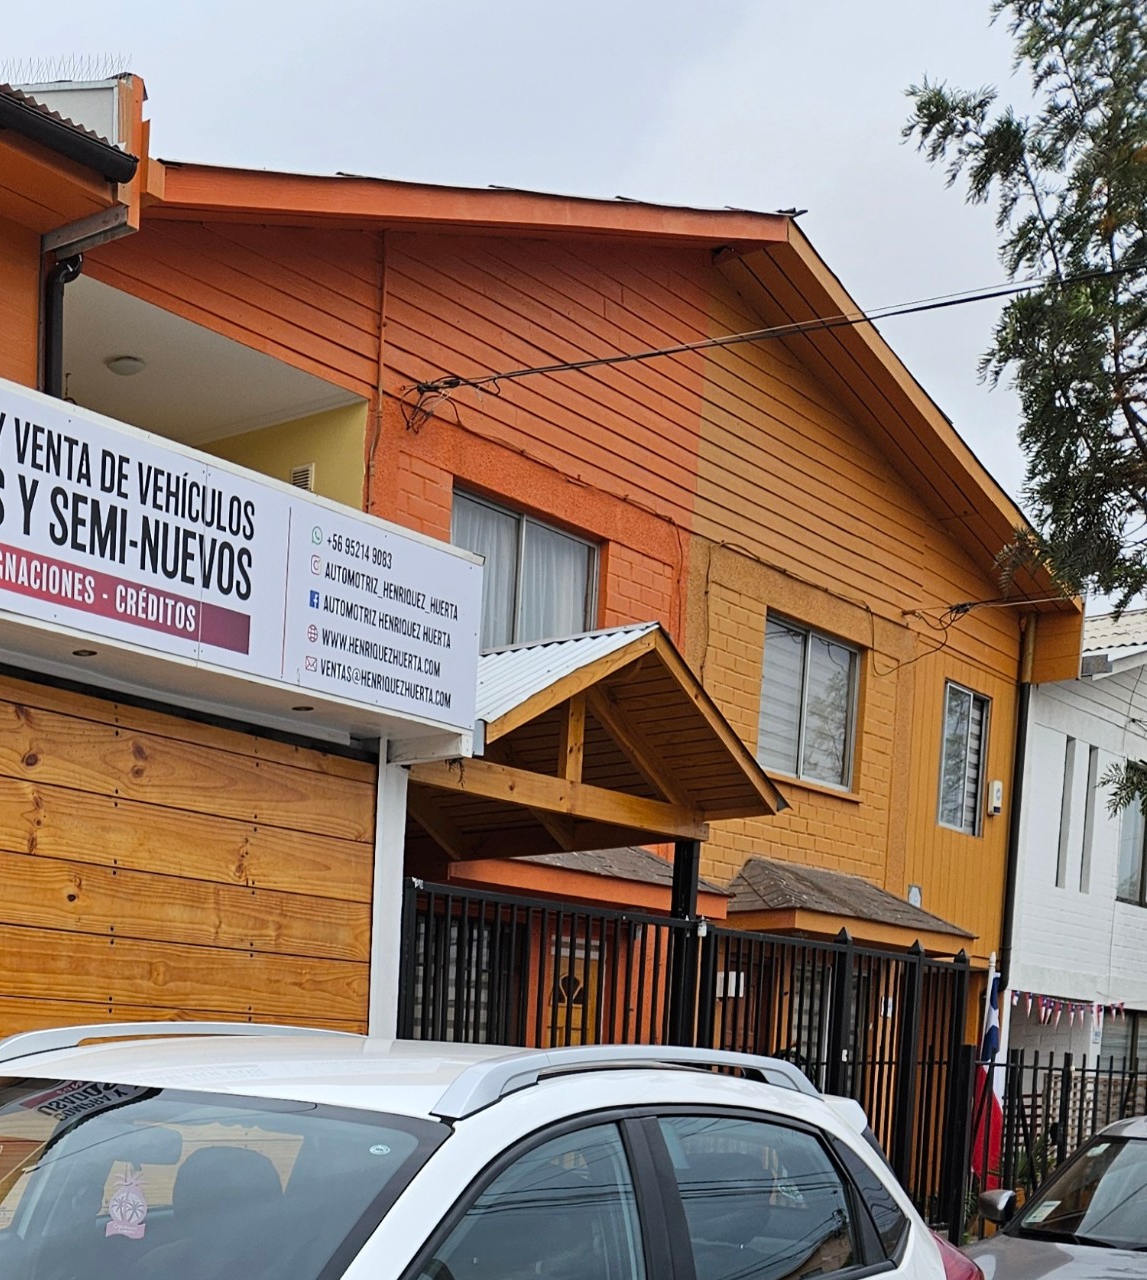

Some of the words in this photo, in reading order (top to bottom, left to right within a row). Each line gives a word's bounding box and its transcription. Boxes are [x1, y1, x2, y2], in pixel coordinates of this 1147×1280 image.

[14, 416, 92, 488] VENTA
[100, 448, 129, 500] DE
[137, 461, 255, 541] VEHÍCULOS
[18, 474, 40, 536] Y
[49, 486, 253, 601] SEMI-NUEVOS
[326, 533, 343, 552] +56
[345, 537, 370, 562] 95214
[371, 546, 393, 570] 9083
[115, 583, 196, 633] CRÉDITOS
[323, 595, 377, 627] AUTOMOTRIZ
[378, 612, 421, 641] HENRIQUEZ
[422, 625, 451, 649] HUERTA
[321, 628, 441, 678] WWW.HENRIQUEZHUERTA.COM
[320, 658, 452, 709] VENTAS@HENRIQUEZHUERTA.COM
